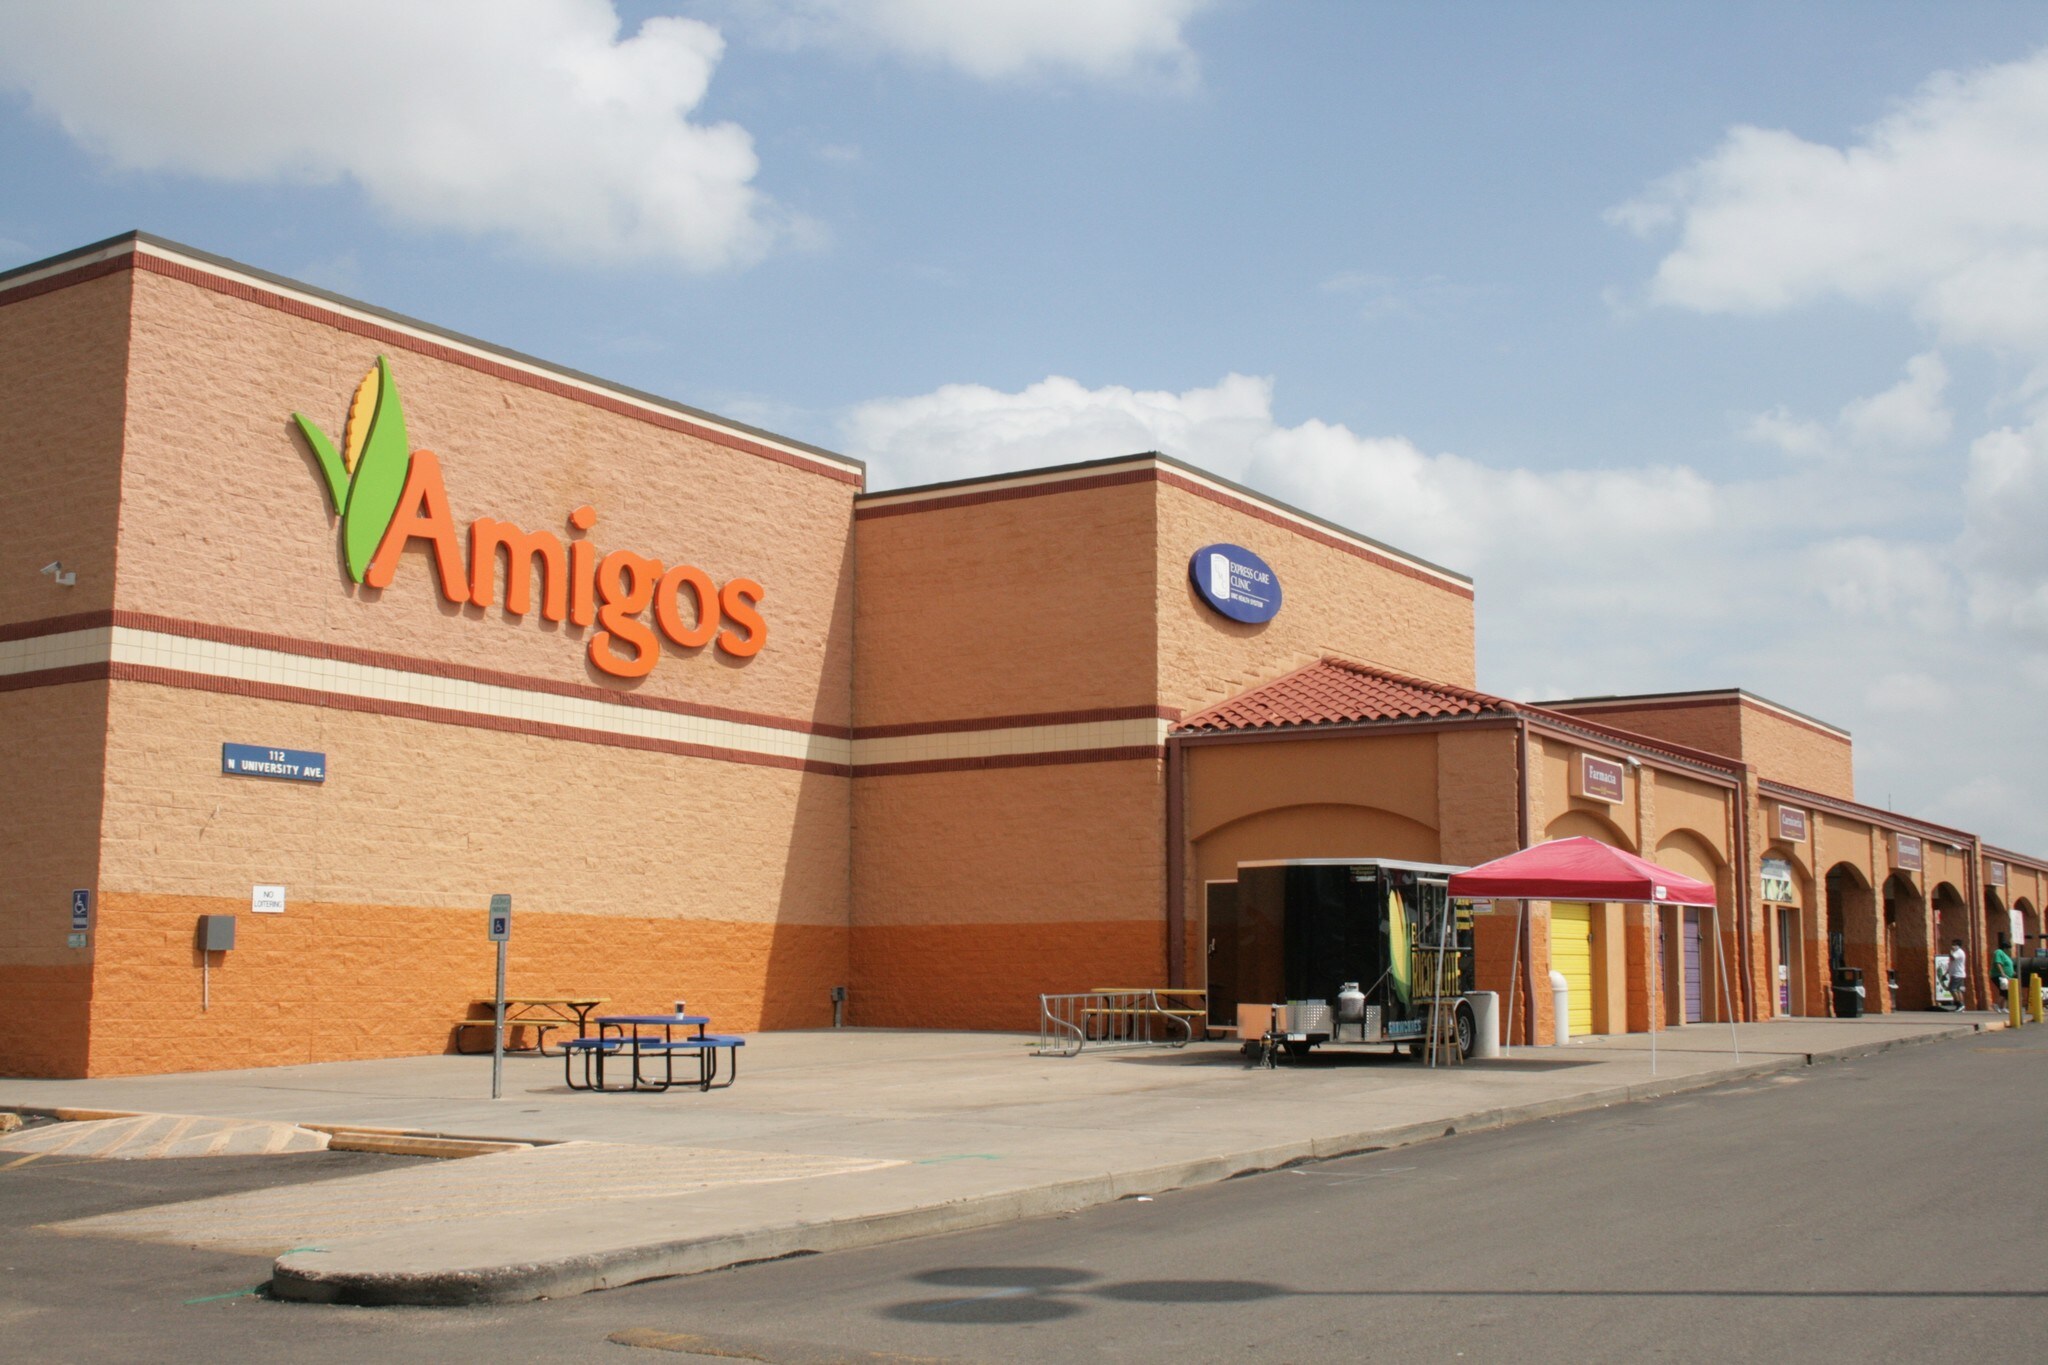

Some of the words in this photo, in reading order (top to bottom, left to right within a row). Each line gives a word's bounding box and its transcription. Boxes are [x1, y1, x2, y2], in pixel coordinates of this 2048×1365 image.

[365, 449, 768, 678] Amigos
[1230, 561, 1254, 580] EXPRESS
[1254, 570, 1270, 585] CARE
[1230, 575, 1252, 592] CLINIC
[269, 750, 286, 762] 112
[227, 758, 236, 770] N
[241, 759, 299, 776] UNIVERSITY
[1589, 764, 1617, 785] Farmacia
[263, 890, 274, 899] NO
[1411, 951, 1434, 999] RICO
